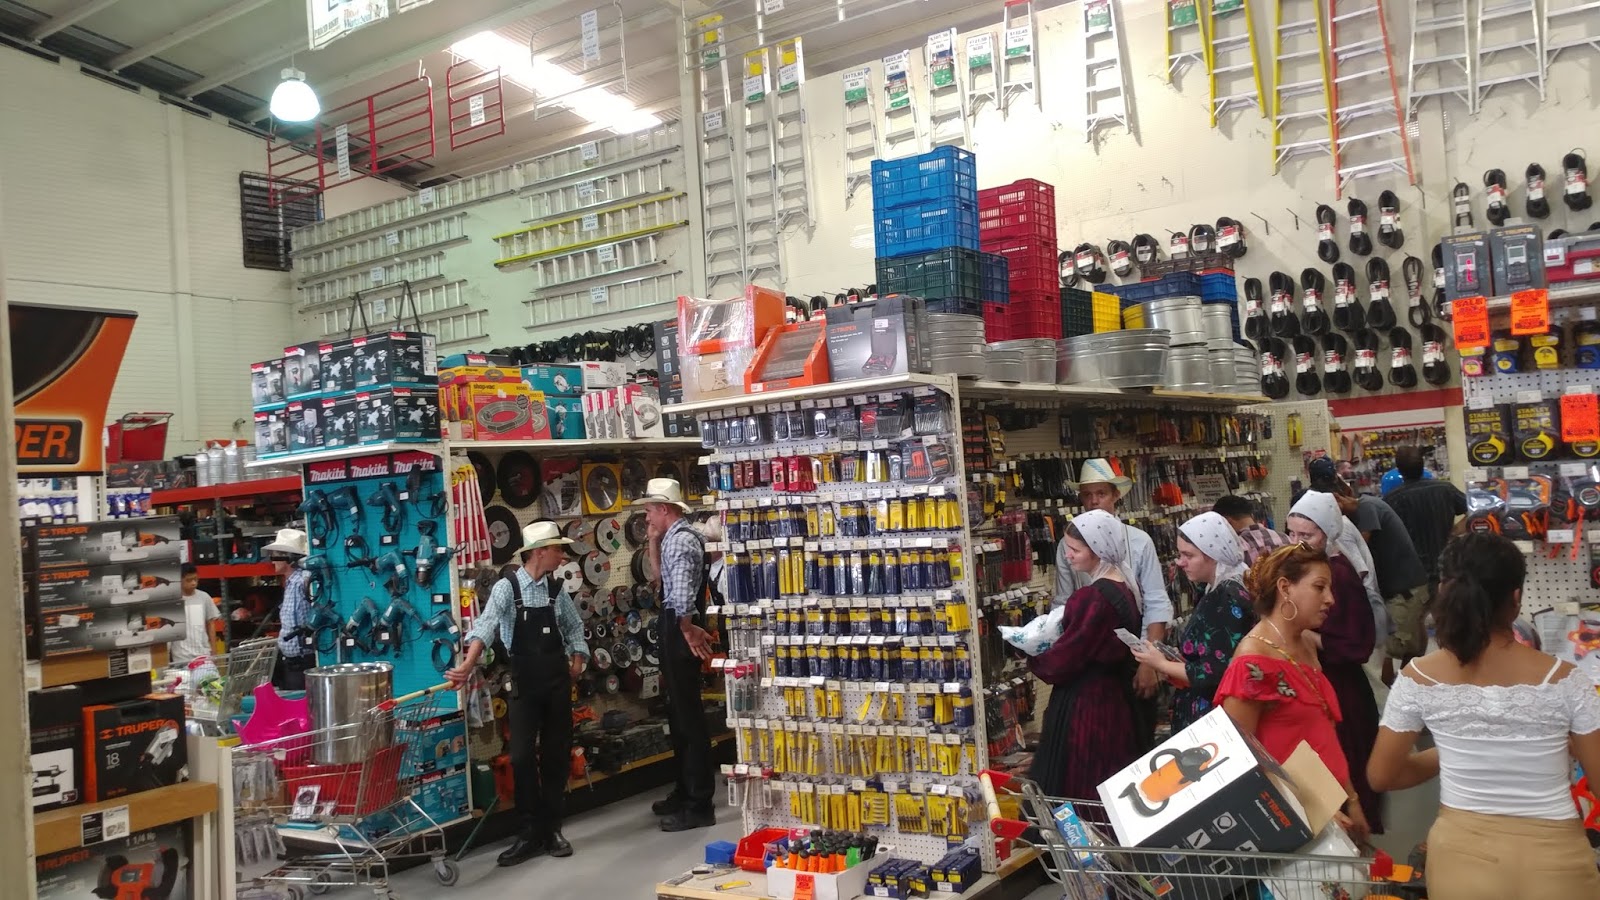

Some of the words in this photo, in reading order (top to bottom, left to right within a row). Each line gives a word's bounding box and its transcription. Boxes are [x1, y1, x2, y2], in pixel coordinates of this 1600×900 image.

[51, 526, 89, 535] TRUPER
[51, 569, 90, 580] TRUPER
[116, 719, 165, 737] TRUPER
[106, 752, 120, 765] 18
[1267, 798, 1292, 828] TRUPER
